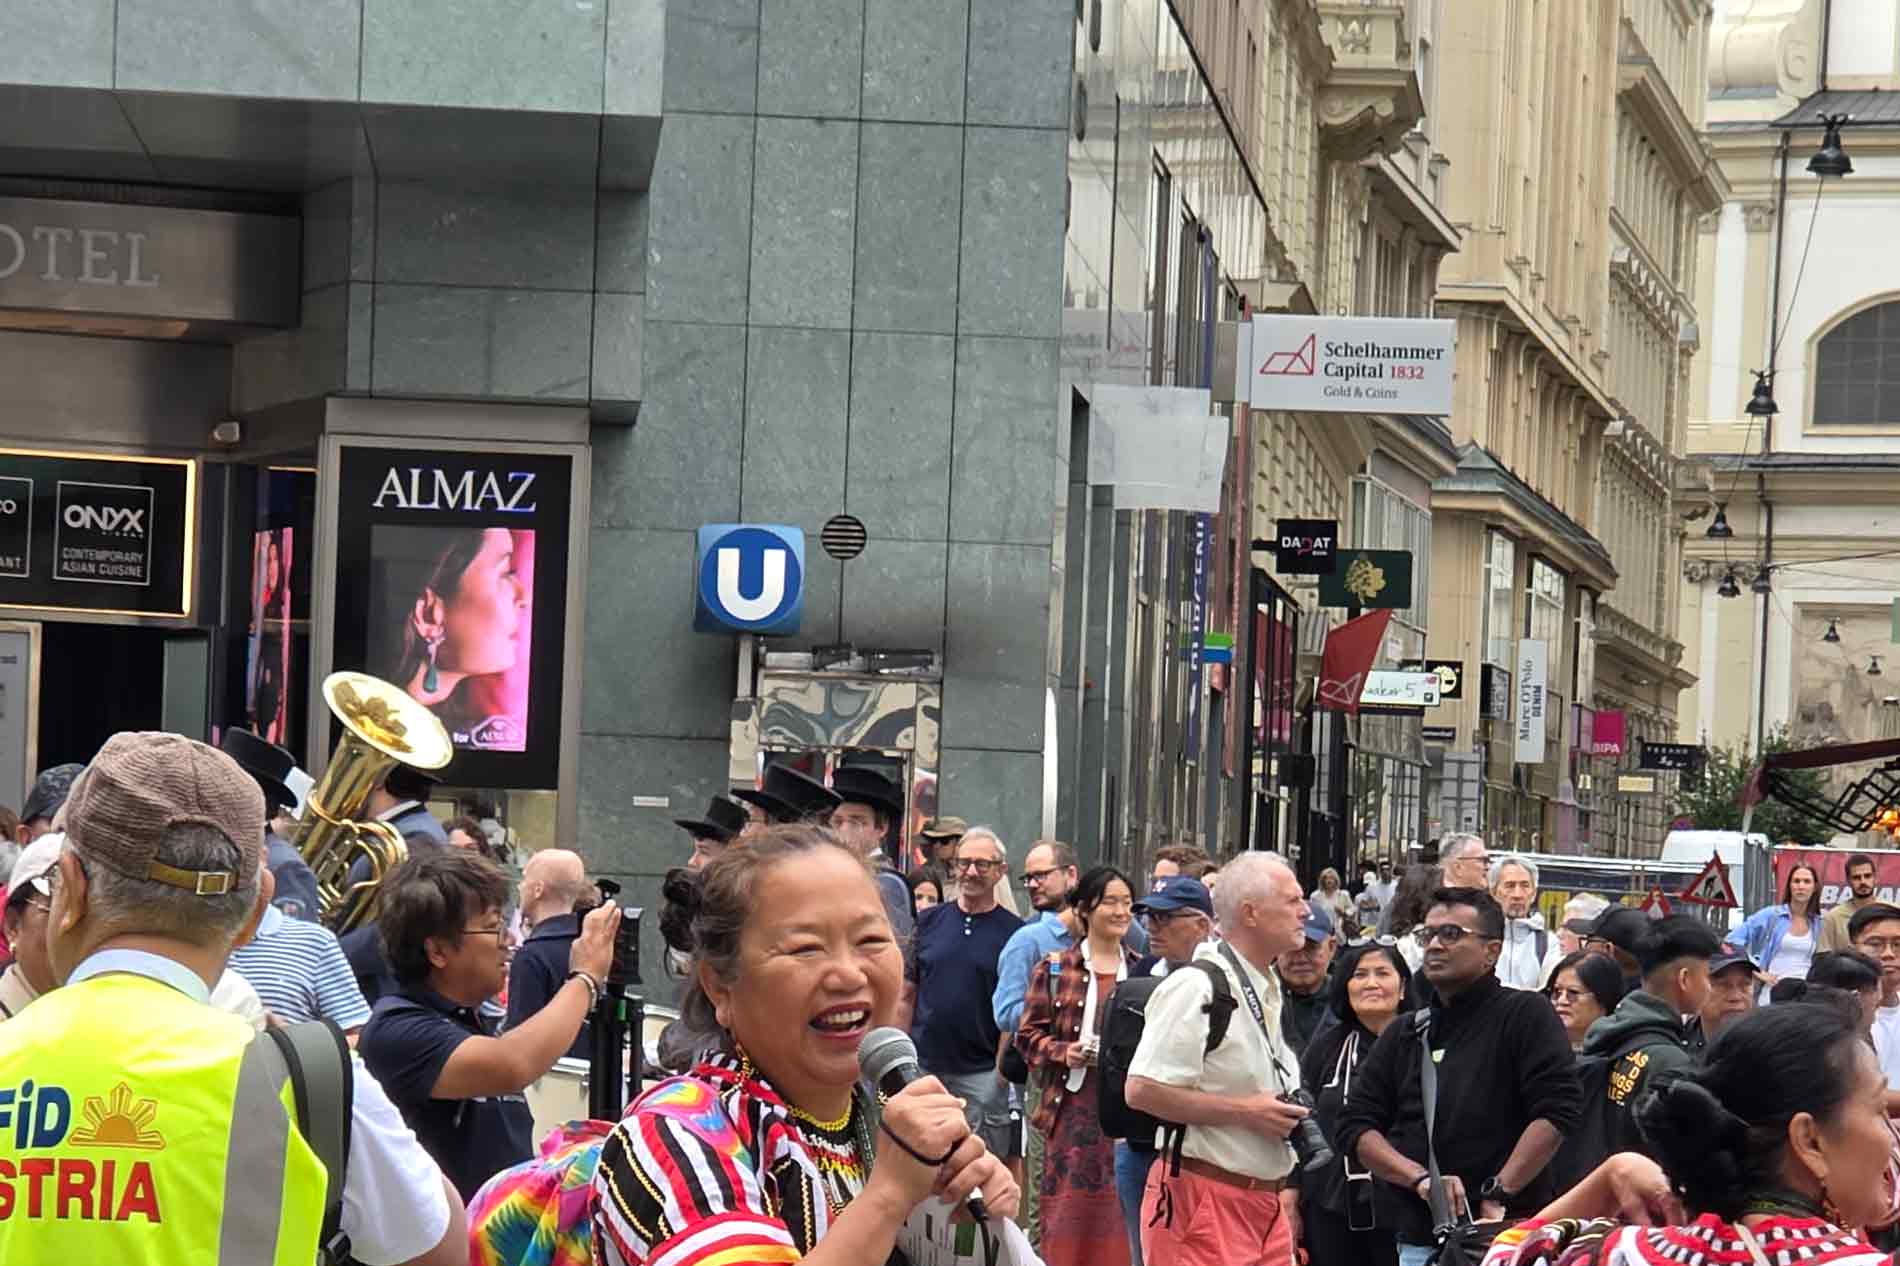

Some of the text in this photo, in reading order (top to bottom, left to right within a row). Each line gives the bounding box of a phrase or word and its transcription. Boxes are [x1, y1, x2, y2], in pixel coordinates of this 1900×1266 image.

[1324, 341, 1445, 361] Schelhammer
[1324, 362, 1425, 381] Capital 1832
[1323, 385, 1351, 398] Gold
[371, 466, 537, 513] ALMAZ
[63, 504, 145, 533] ONYX
[62, 547, 144, 563] CONTEMPORARY
[62, 561, 143, 578] ASIAN CUISINE
[717, 547, 786, 621] U
[1519, 705, 1530, 743] Marc
